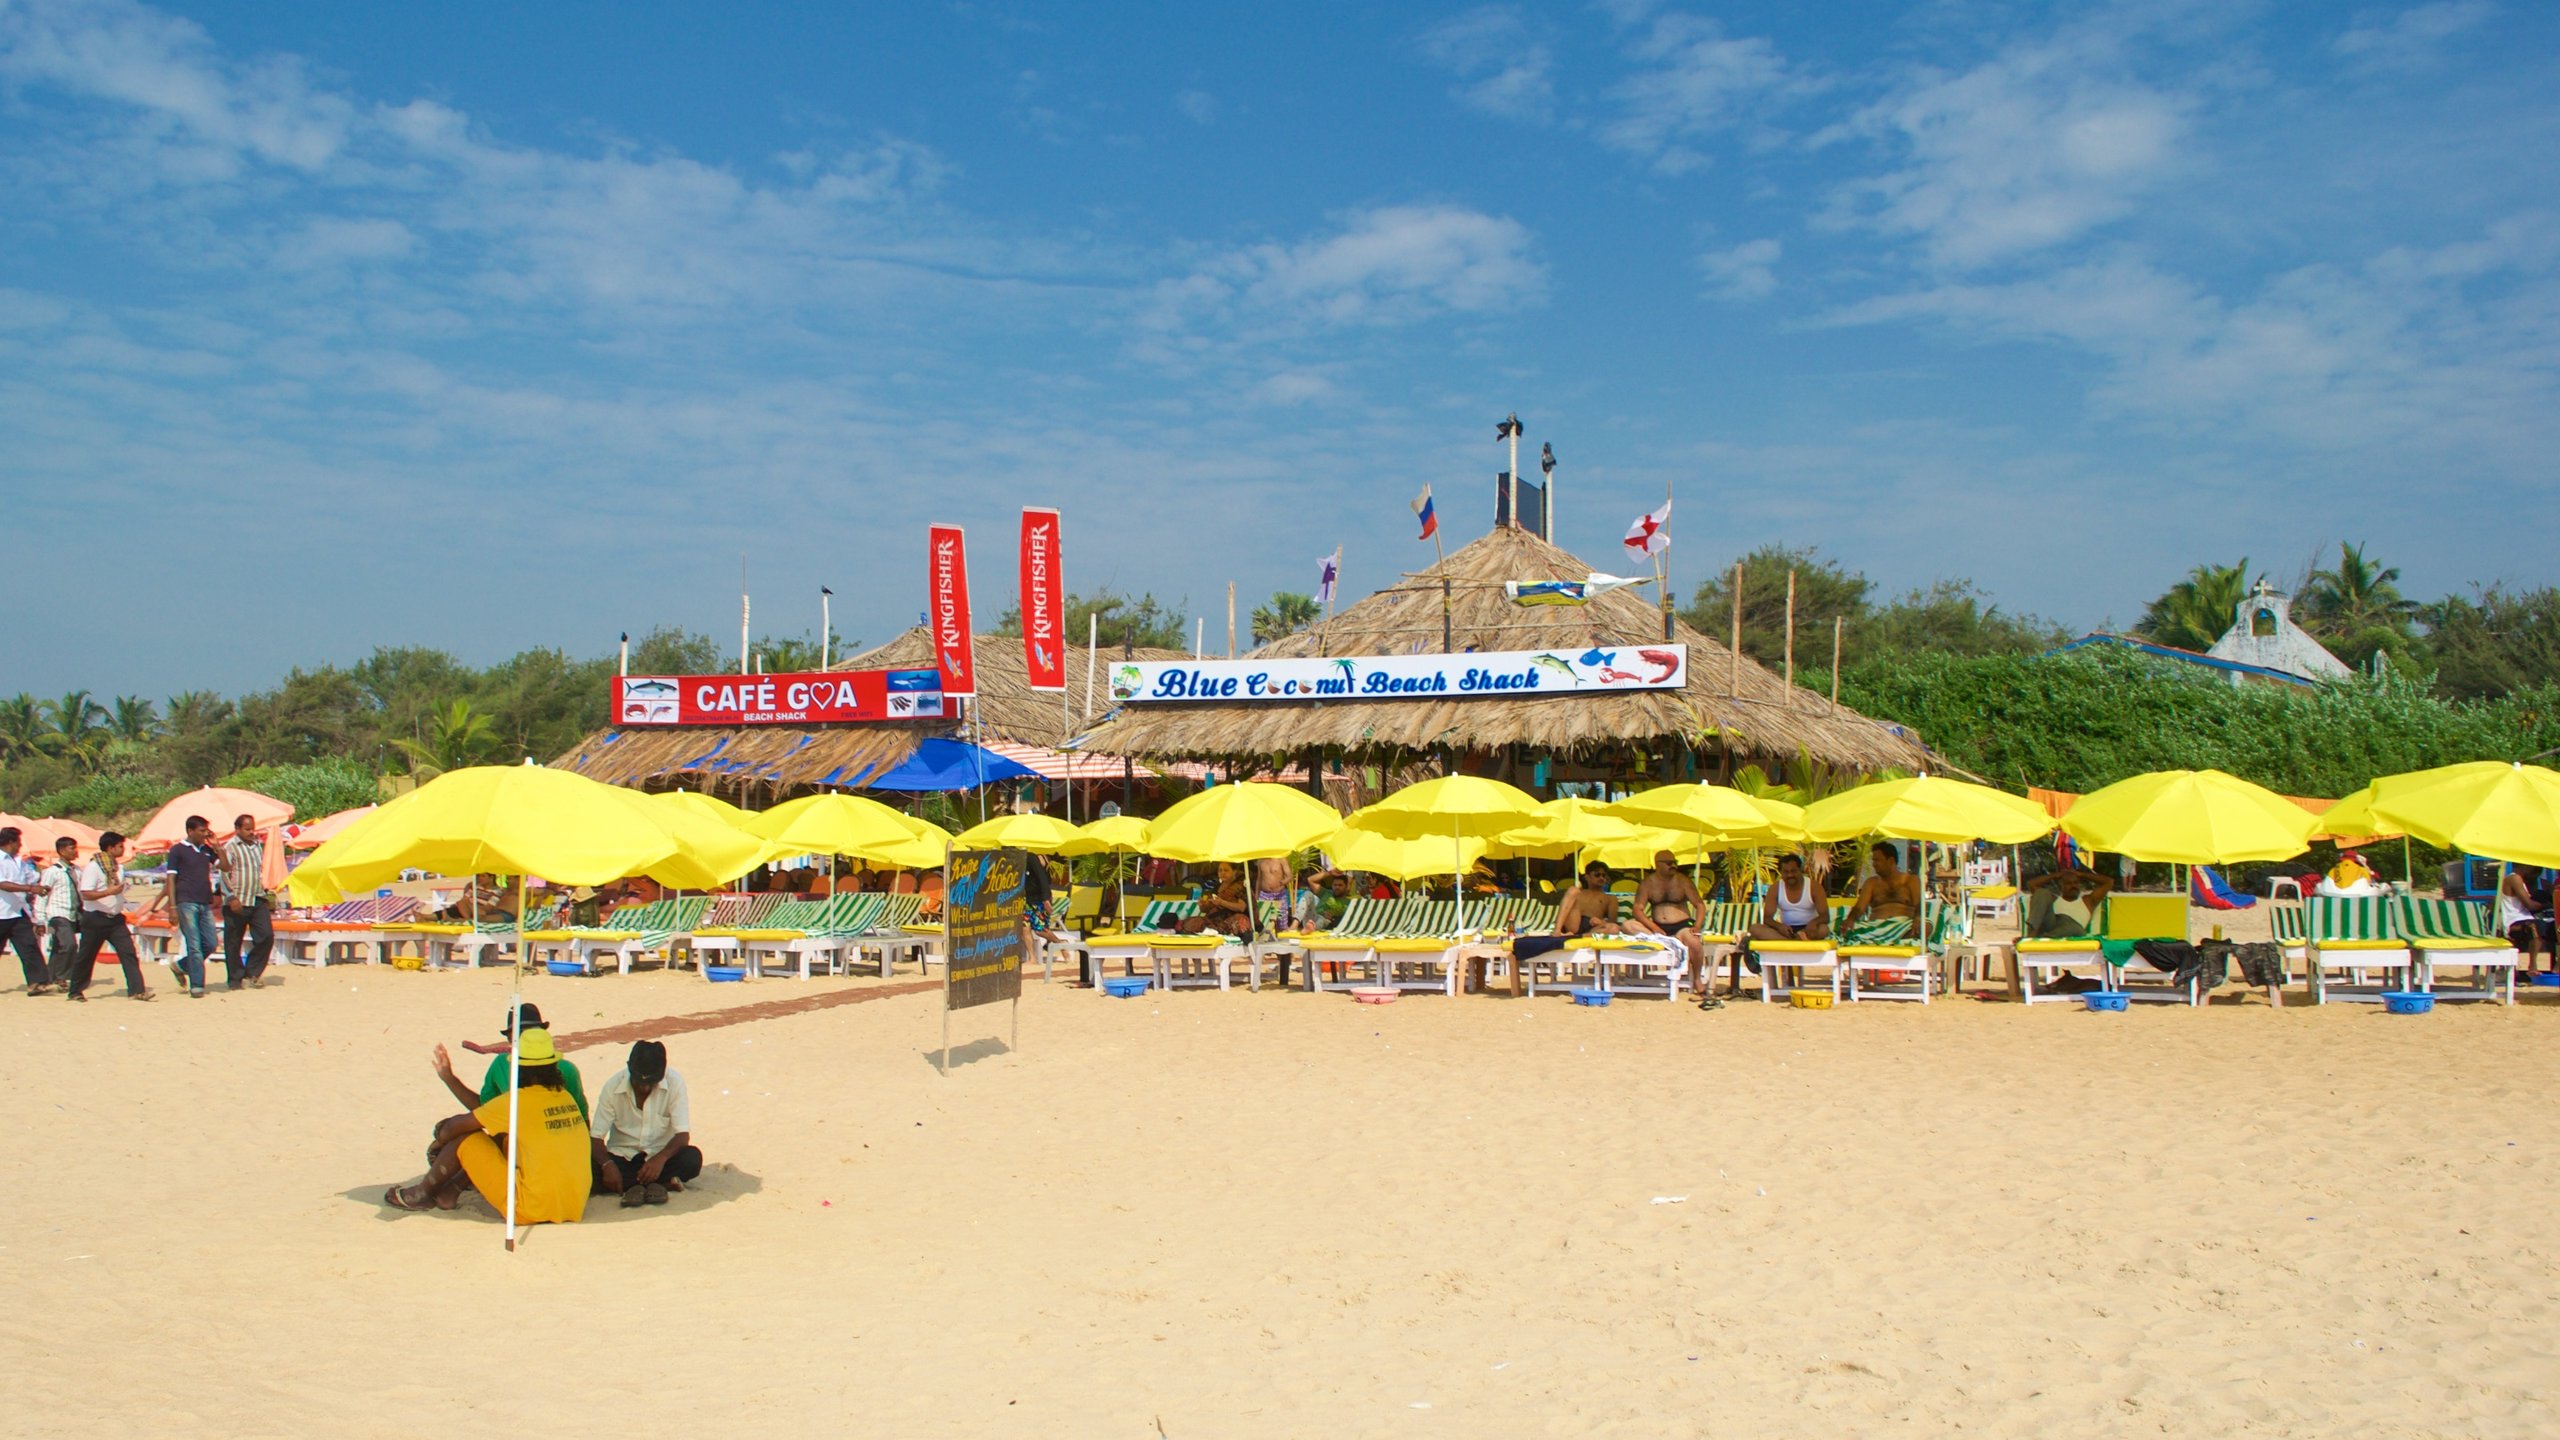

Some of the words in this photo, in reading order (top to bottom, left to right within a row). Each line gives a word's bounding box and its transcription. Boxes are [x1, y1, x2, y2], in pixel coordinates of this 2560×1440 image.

[937, 537, 960, 648] KINGFISHER
[1031, 521, 1050, 640] KINGFISHER
[696, 677, 776, 712] CAFÉ
[1152, 667, 1238, 698] Blue
[1361, 671, 1448, 694] Beach
[1458, 666, 1540, 691] Shack
[743, 712, 774, 722] BEACH
[775, 711, 807, 721] SHACK
